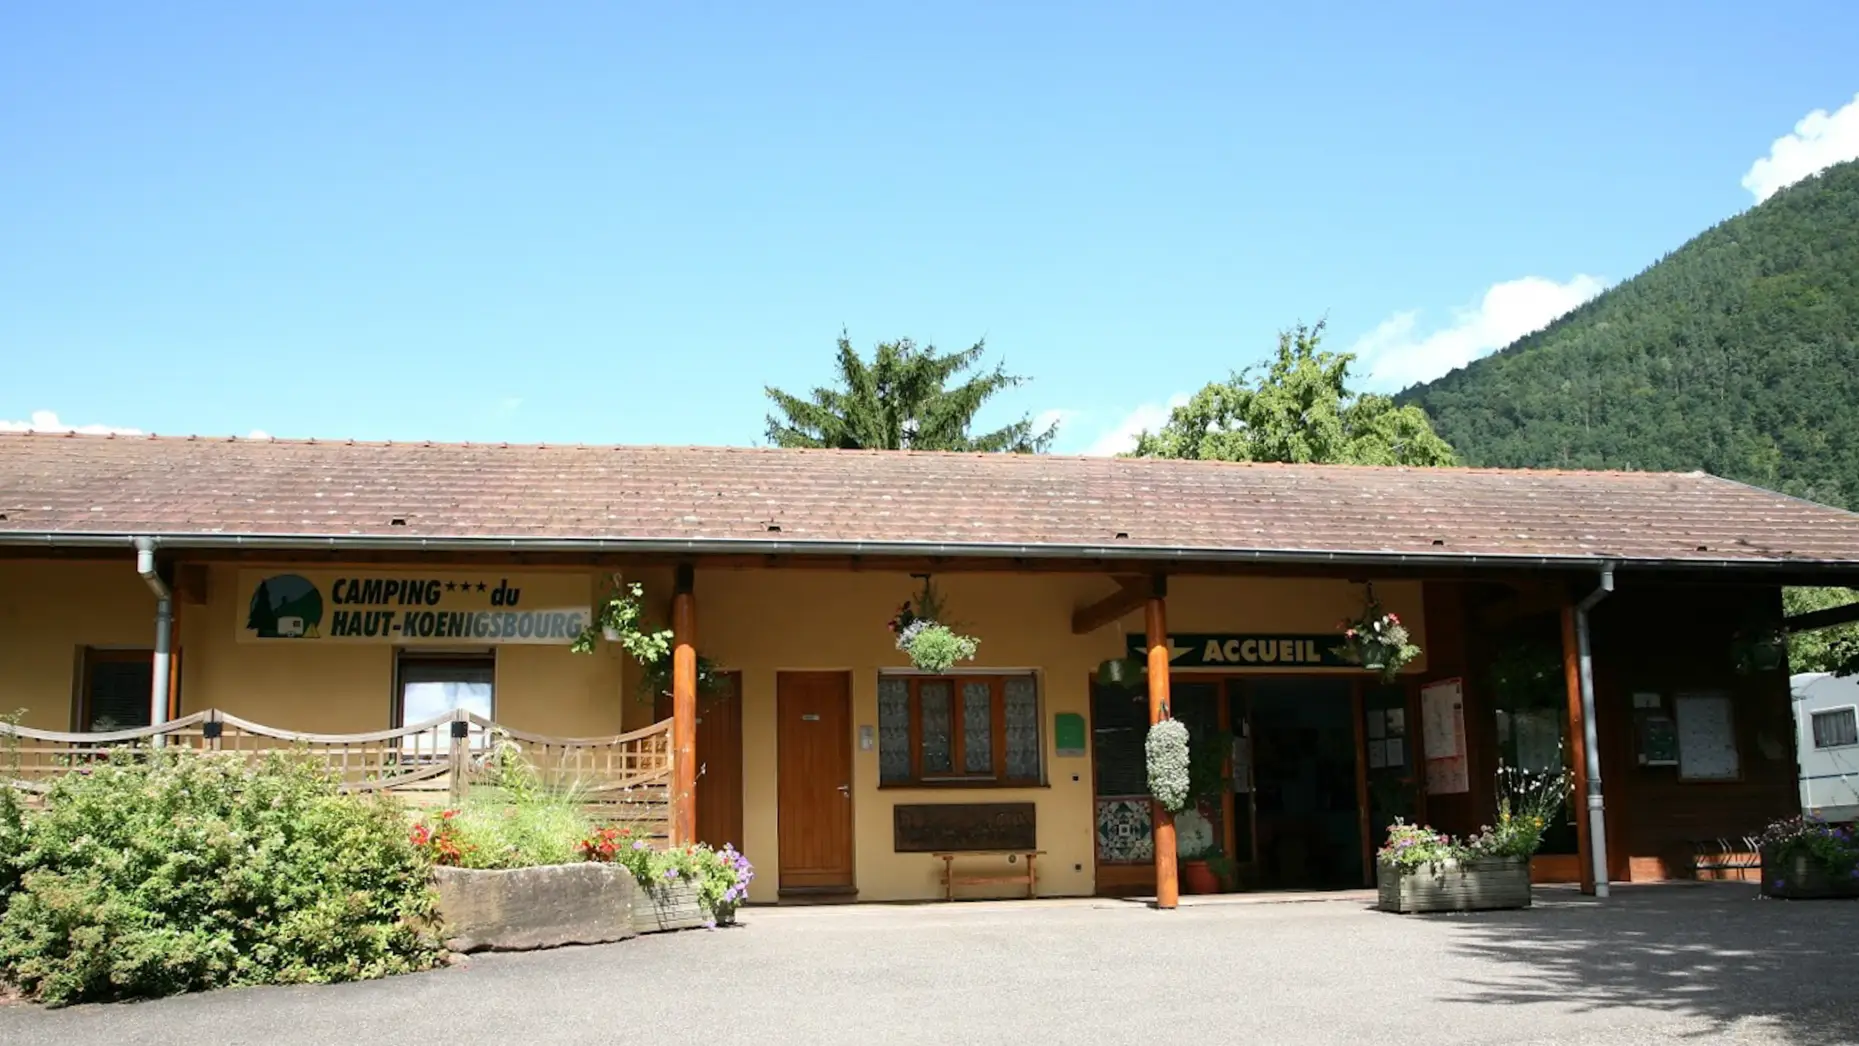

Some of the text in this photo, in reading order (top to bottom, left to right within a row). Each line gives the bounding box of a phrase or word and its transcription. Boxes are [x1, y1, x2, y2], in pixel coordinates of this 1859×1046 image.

[332, 578, 520, 606] CAMPING du
[331, 611, 582, 637] HAUT-KOENIGSBOURG
[1203, 639, 1321, 662] ACCUEIL
